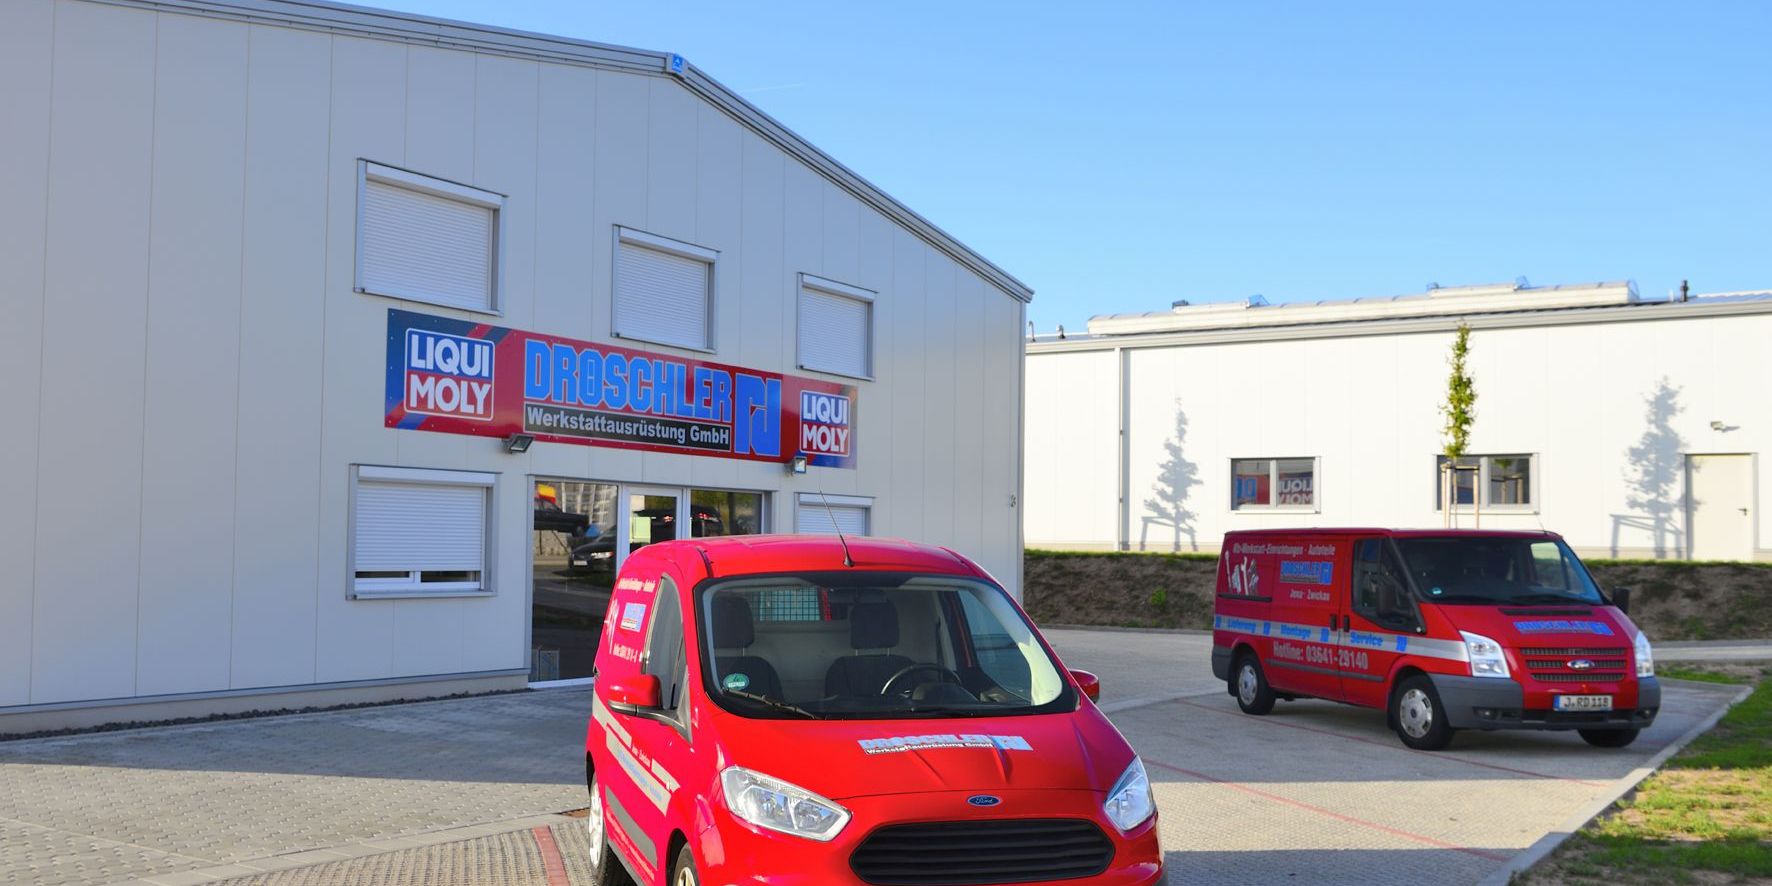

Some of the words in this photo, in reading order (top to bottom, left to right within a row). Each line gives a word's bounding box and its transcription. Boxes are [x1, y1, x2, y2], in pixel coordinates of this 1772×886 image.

[411, 334, 489, 377] LIQUI
[409, 374, 491, 415] MOLY
[524, 338, 732, 423] DROSCHLER
[527, 406, 686, 444] Werkstattausrüstung
[690, 425, 729, 444] GmbH
[803, 394, 848, 425] LIQUI
[802, 423, 848, 453] MOLY
[1350, 631, 1383, 647] Service
